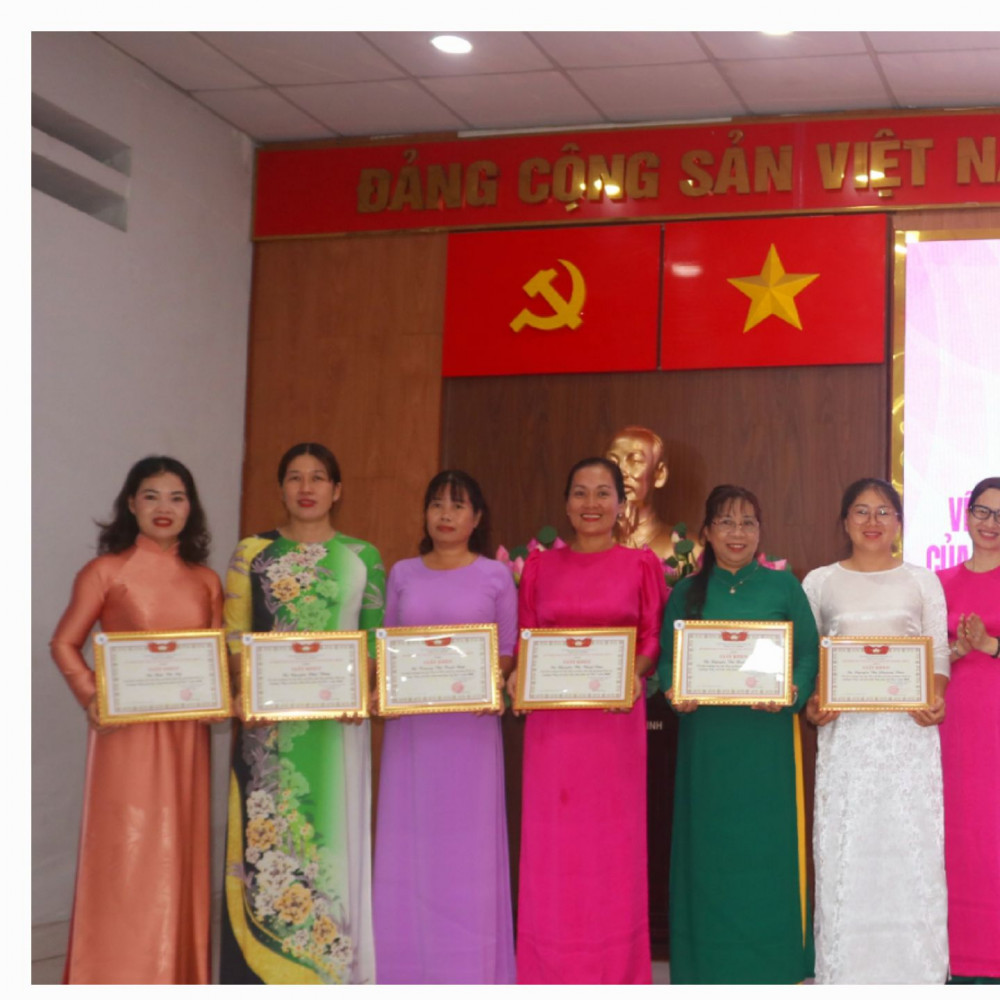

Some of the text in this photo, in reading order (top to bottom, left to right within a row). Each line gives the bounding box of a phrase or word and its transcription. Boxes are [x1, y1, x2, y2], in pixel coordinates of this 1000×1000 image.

[357, 149, 499, 214] ĐẢNG
[517, 143, 661, 211] CỘNG
[679, 129, 793, 195] SẢN
[816, 128, 934, 197] VIỆT
